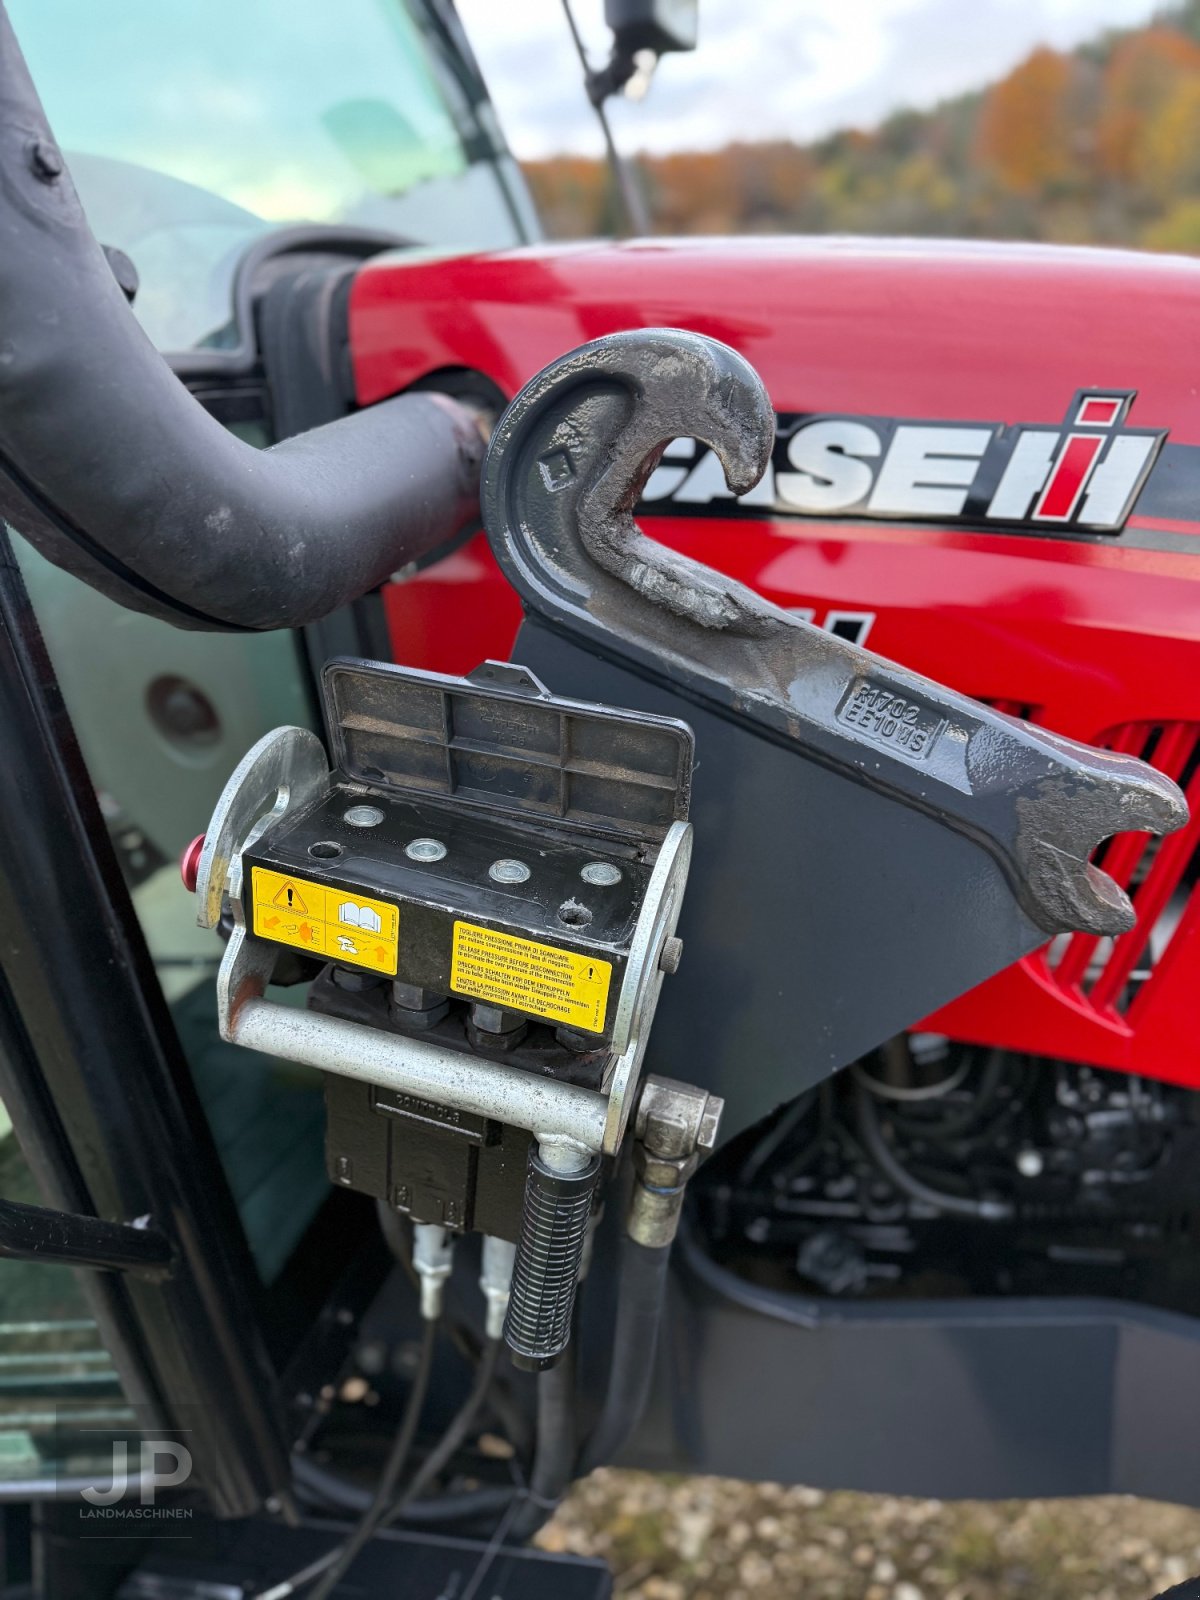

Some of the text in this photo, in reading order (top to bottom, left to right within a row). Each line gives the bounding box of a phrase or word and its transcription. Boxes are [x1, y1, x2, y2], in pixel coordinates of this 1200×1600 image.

[854, 683, 921, 725] R1702
[459, 928, 483, 939] TOGLIERE
[484, 934, 512, 947] PRESSIONE
[514, 942, 531, 952] PRIMA
[458, 944, 572, 980] RELEASE PRESSURE BEFORE DISCONNECTION
[484, 984, 510, 996] PRESSION
[510, 992, 528, 1001] AVANT
[485, 968, 511, 979] SCHALTEN
[512, 975, 523, 983] VOR
[536, 982, 570, 996] ENTKUPPELN
